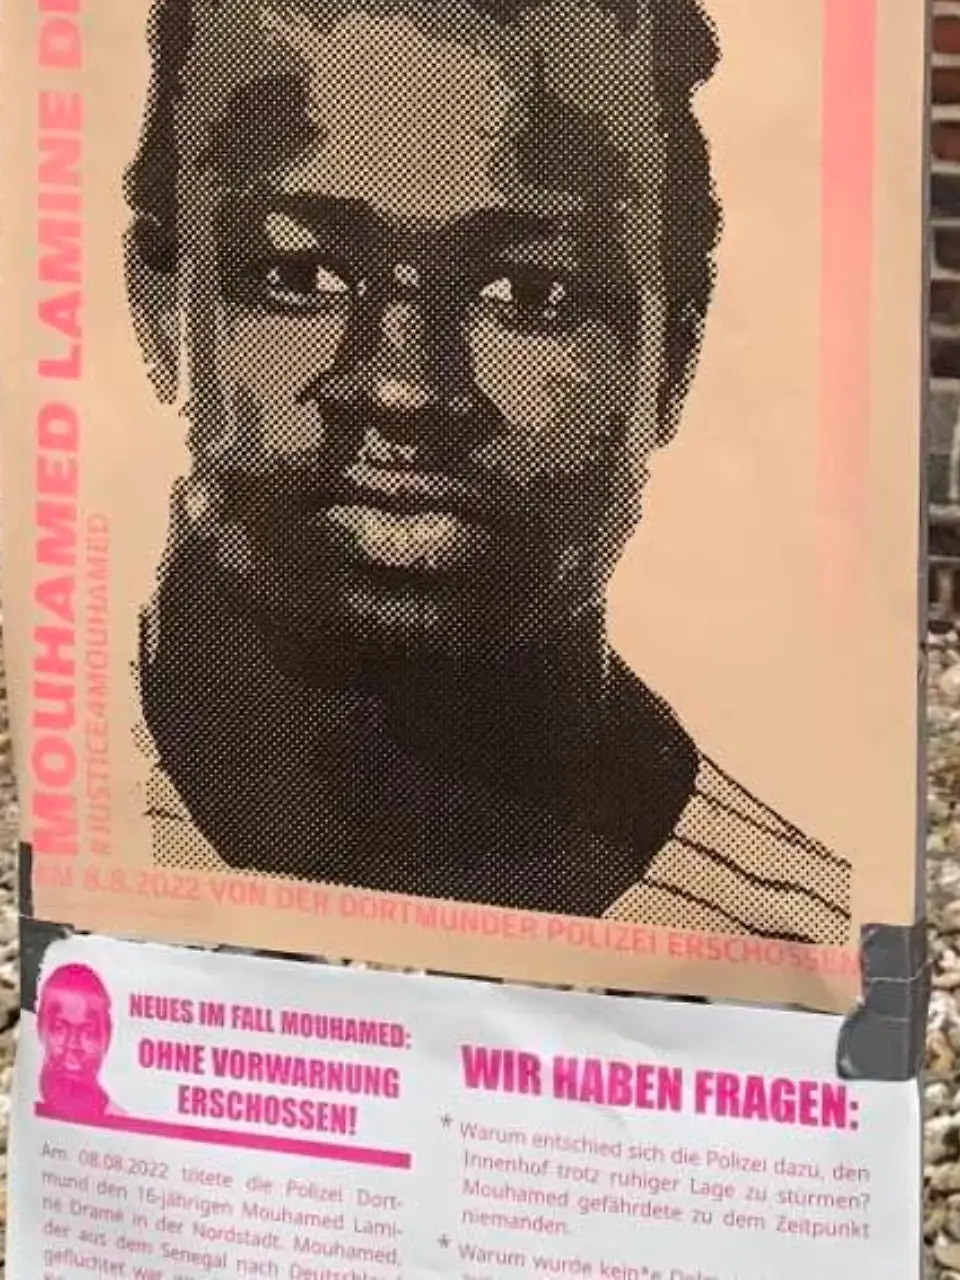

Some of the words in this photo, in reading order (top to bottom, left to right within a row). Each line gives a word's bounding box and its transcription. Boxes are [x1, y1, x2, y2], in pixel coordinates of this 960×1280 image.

[37, 89, 84, 380] LAMINE
[30, 400, 81, 856] MOUHAMED
[212, 878, 268, 907] VON
[276, 886, 329, 914] DER
[339, 895, 536, 939] DORTMUNDER
[548, 918, 658, 956] POLIZEI
[668, 933, 860, 977] ERSCHOSSEN
[130, 994, 194, 1024] NEUES
[200, 1002, 226, 1029] IM
[231, 1006, 275, 1034] FALL
[280, 1010, 412, 1050] MOUHAMED:
[138, 1038, 206, 1076] OHNE
[211, 1049, 400, 1099] VORWARNUNG
[461, 1044, 543, 1096] WIR
[553, 1055, 683, 1112] HABEN
[694, 1070, 860, 1131] FRAGEN:
[178, 1084, 358, 1135] ERSCHOSSEN!
[460, 1122, 527, 1144] Warum
[531, 1134, 623, 1159] entschied
[627, 1143, 665, 1163] sich
[670, 1146, 700, 1166] die
[706, 1150, 768, 1172] Polizei
[774, 1157, 826, 1182] dazu,
[832, 1162, 871, 1183] den
[463, 1149, 550, 1177] Innenhof
[556, 1163, 600, 1184] trotz
[609, 1170, 681, 1196] ruhiger
[690, 1177, 737, 1201] Lage
[744, 1186, 768, 1202] zu
[42, 1171, 89, 1192] mund
[96, 1180, 128, 1201] den
[242, 1202, 344, 1231] Mouhamed
[246, 1176, 273, 1194] die
[286, 1179, 344, 1203] Polizei
[462, 1178, 570, 1208] Mouhamed
[577, 1195, 684, 1220] gefährdete
[691, 1209, 713, 1225] zu
[722, 1211, 766, 1231] dem
[776, 1214, 871, 1240] Zeitpunkt
[43, 1220, 70, 1237] der
[116, 1235, 153, 1253] dem
[161, 1242, 228, 1271] Senegal
[236, 1258, 279, 1276] nach
[155, 1216, 184, 1235] der
[457, 1243, 526, 1267] Warum
[532, 1254, 593, 1273] wurde
